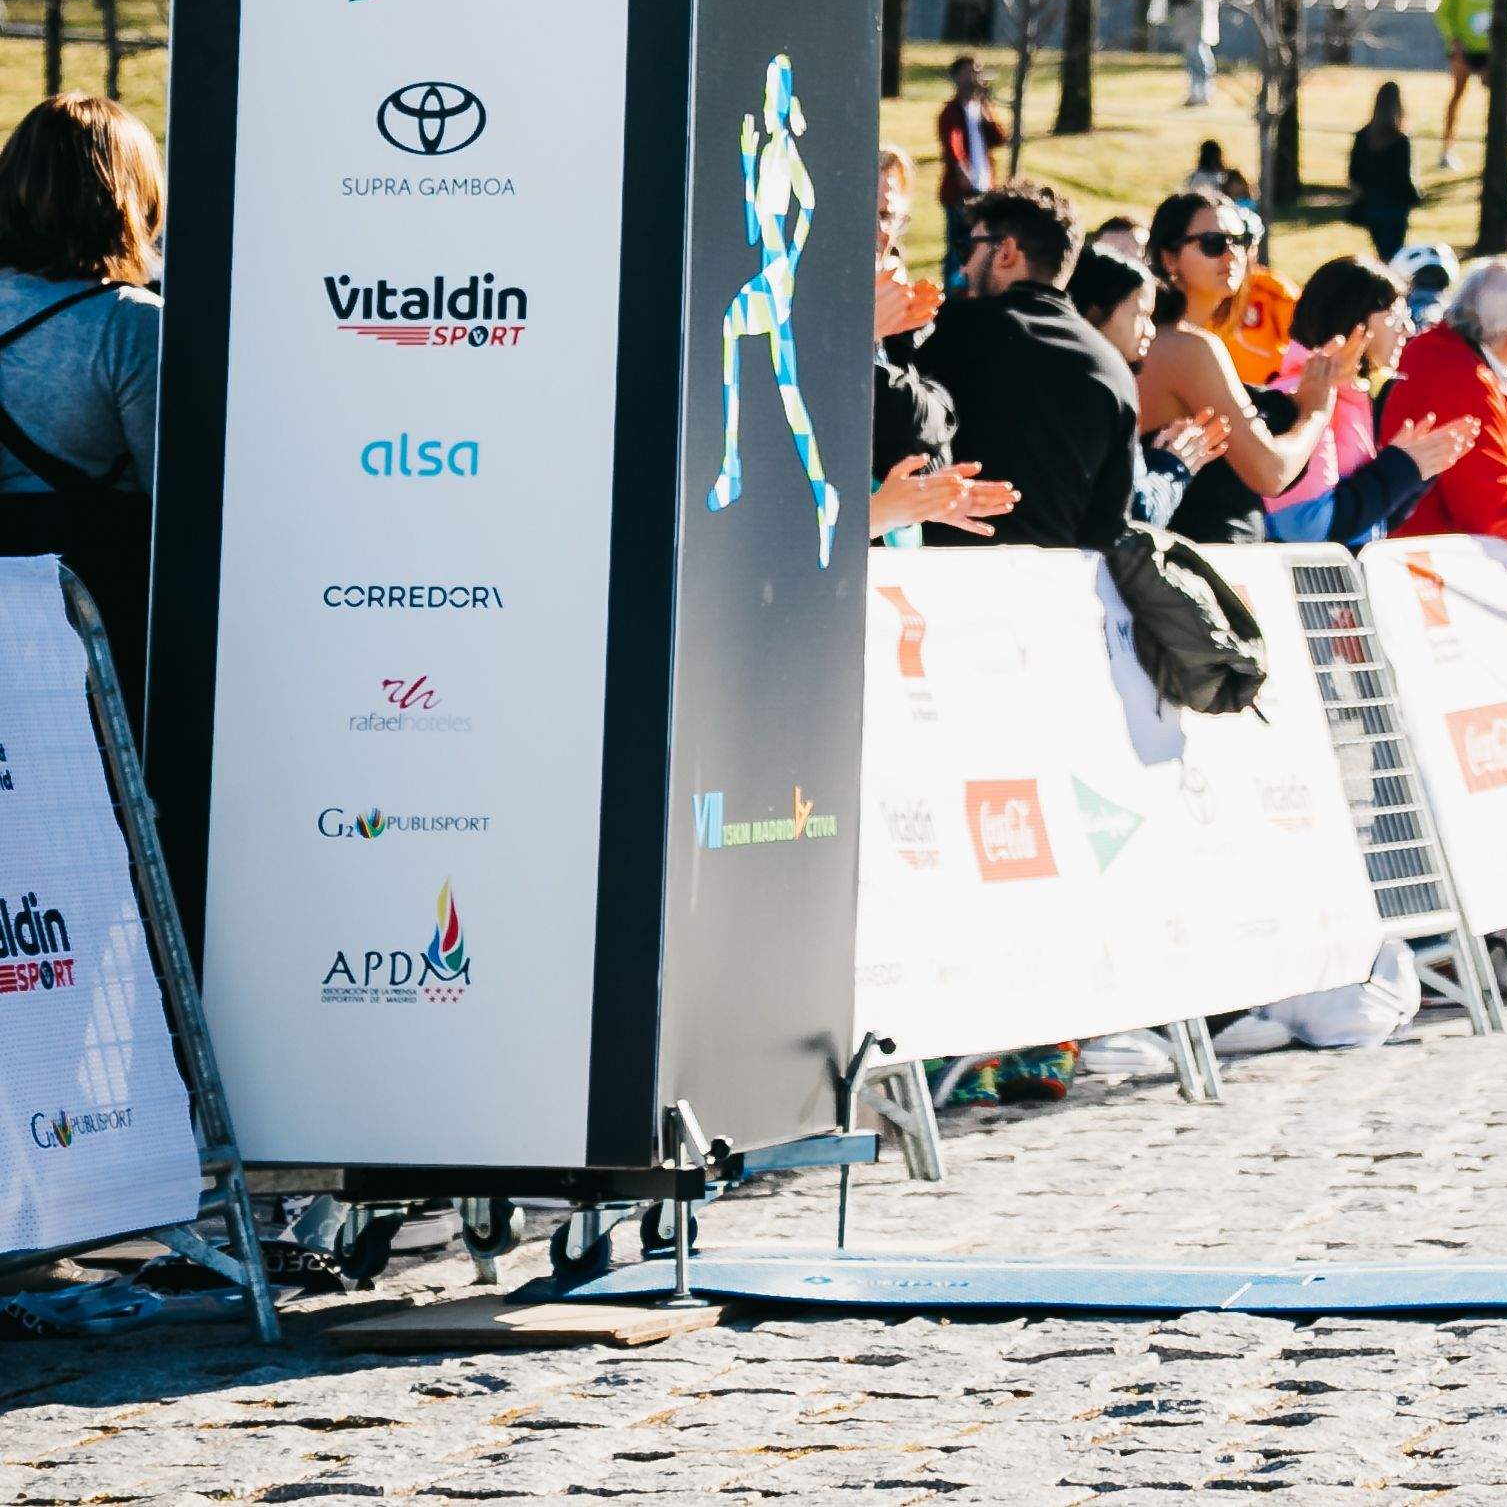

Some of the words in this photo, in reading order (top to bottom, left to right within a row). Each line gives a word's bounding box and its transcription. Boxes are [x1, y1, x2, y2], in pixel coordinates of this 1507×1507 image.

[341, 176, 412, 197] SUPRA
[418, 177, 516, 198] GAMBOA
[323, 272, 528, 320] Vitaldin
[431, 325, 526, 348] SPORT
[360, 432, 480, 477] alsa
[386, 816, 490, 832] PUBLISPORT
[16, 958, 75, 991] SPORT
[321, 950, 471, 987] APDM
